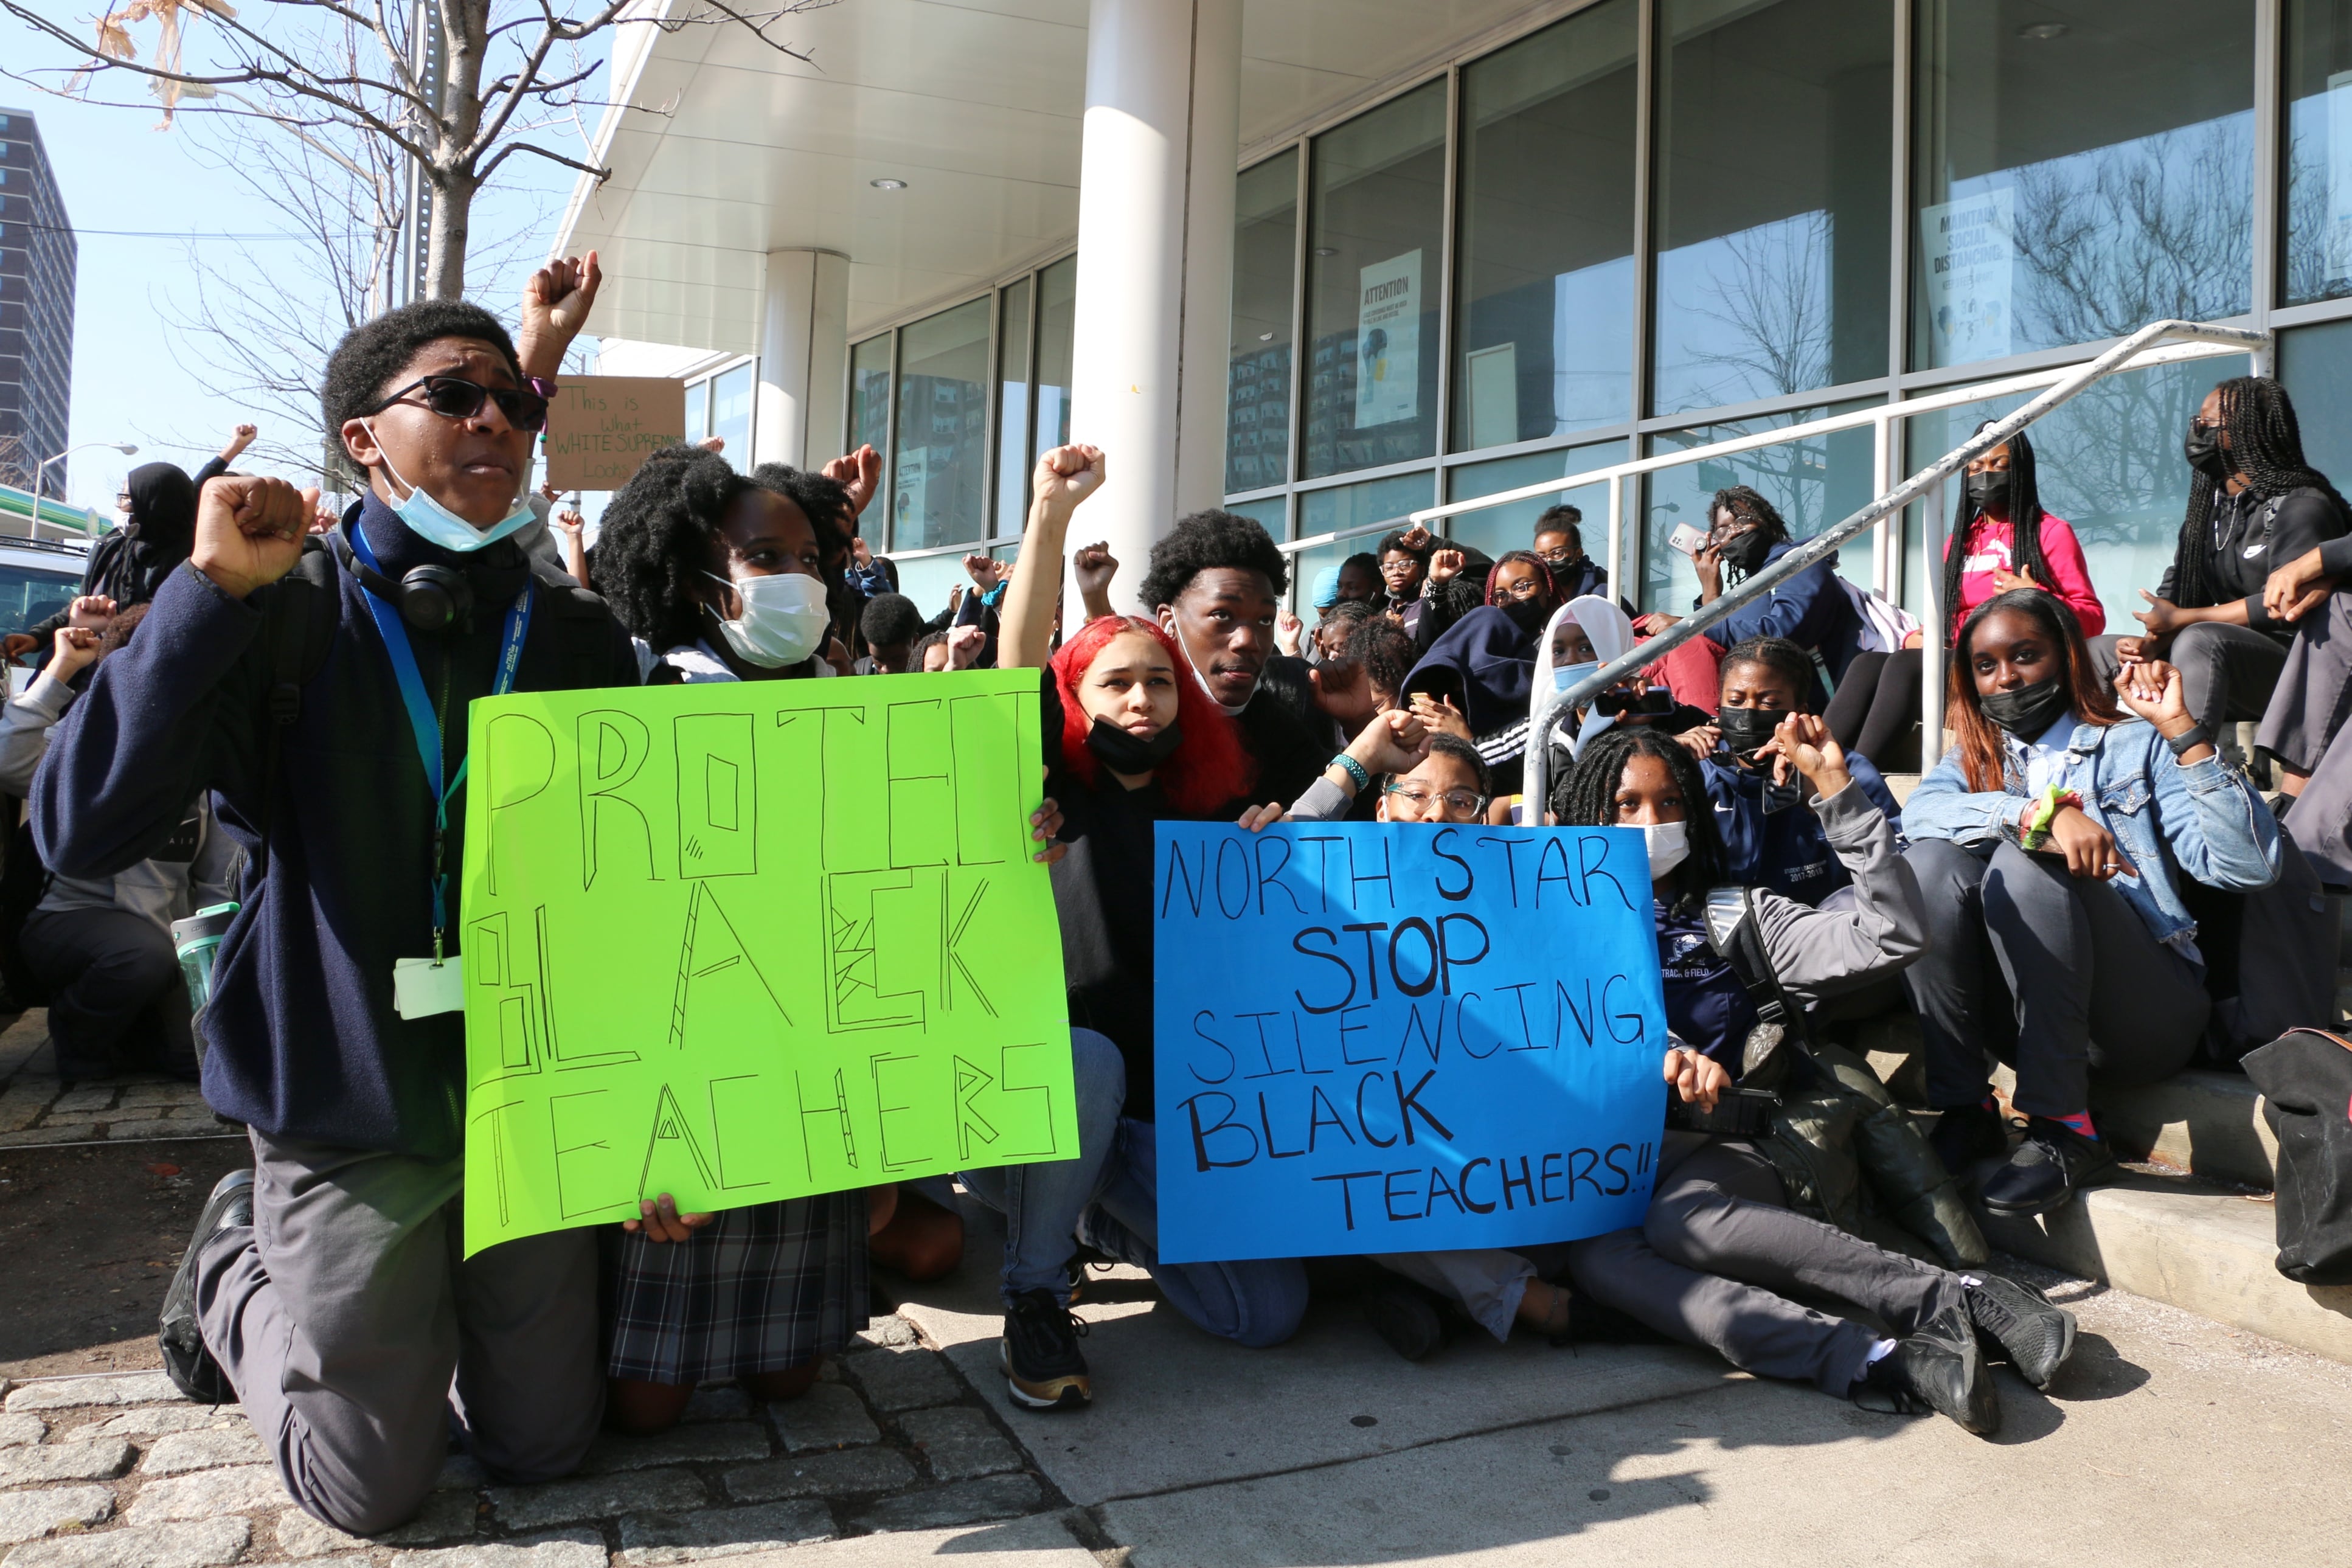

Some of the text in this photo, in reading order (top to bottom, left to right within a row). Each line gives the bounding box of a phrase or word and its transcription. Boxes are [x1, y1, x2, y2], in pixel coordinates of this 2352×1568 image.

[1940, 206, 1997, 233] MAINTAIN
[1948, 227, 1988, 251] SOCIAL
[1364, 276, 1408, 305] ATTENTION
[558, 385, 639, 411] This is
[555, 432, 612, 454] WHITE
[1161, 827, 1637, 920] NORTH STAR
[1790, 867, 1824, 882] 2017-2018
[1292, 912, 1490, 1015] STOP
[1684, 969, 1690, 978] &
[1691, 968, 1709, 977] FIELD
[1187, 974, 1645, 1084] SILENCING
[471, 1042, 1056, 1227] TEACHERS
[1176, 1067, 1454, 1173] BLACK
[1311, 1142, 1653, 1231] TEACHERS!!
